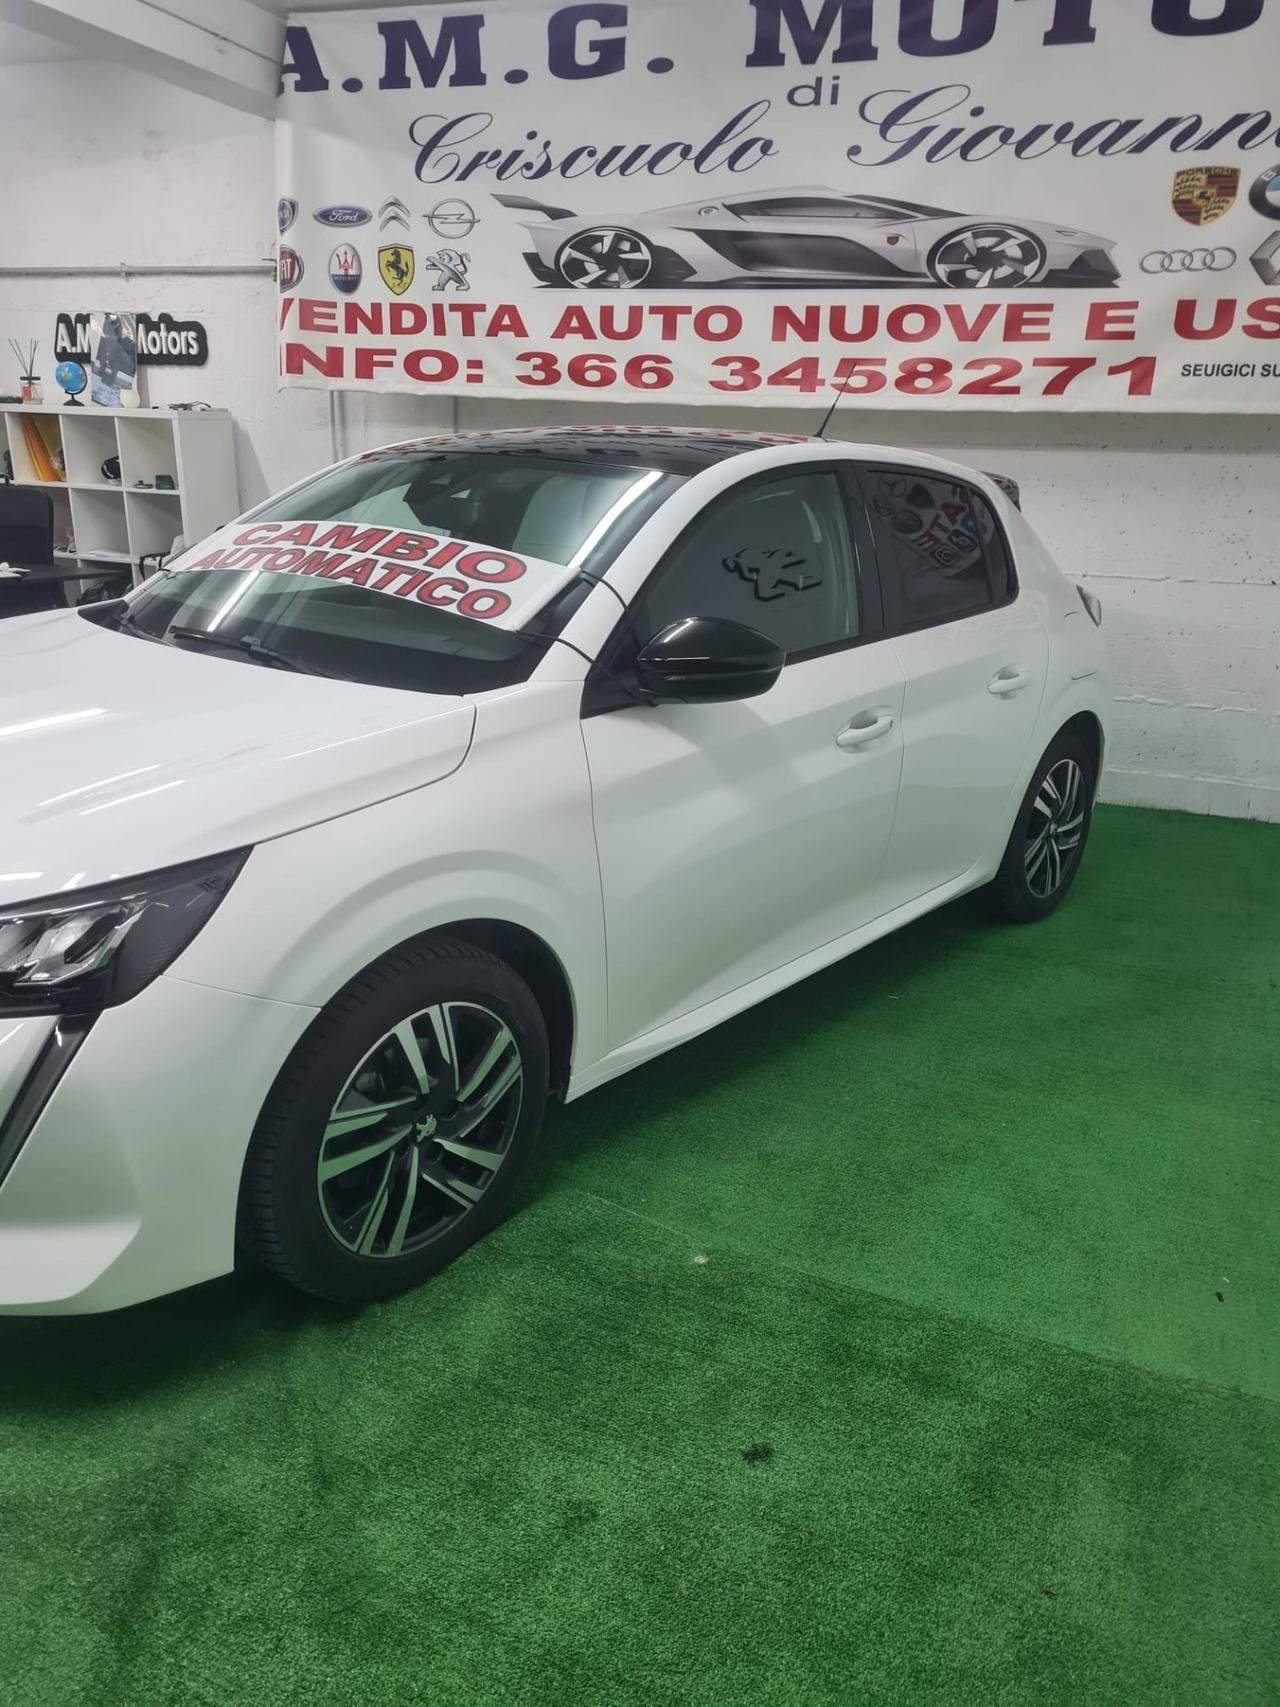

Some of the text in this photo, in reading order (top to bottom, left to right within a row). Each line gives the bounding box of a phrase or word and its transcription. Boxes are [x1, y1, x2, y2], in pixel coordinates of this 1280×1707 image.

[786, 75, 841, 107] di
[408, 83, 1280, 184] Criscuolo Giovann
[328, 209, 360, 222] Ford
[551, 305, 743, 342] AUTO
[770, 303, 1054, 343] NUOVE
[1085, 300, 1140, 341] E
[280, 342, 1157, 396] NFO: 366 3458271
[1181, 363, 1256, 378] SEUIGICI
[232, 522, 527, 584] CAMBIO
[186, 547, 512, 620] AUTOMATICO
